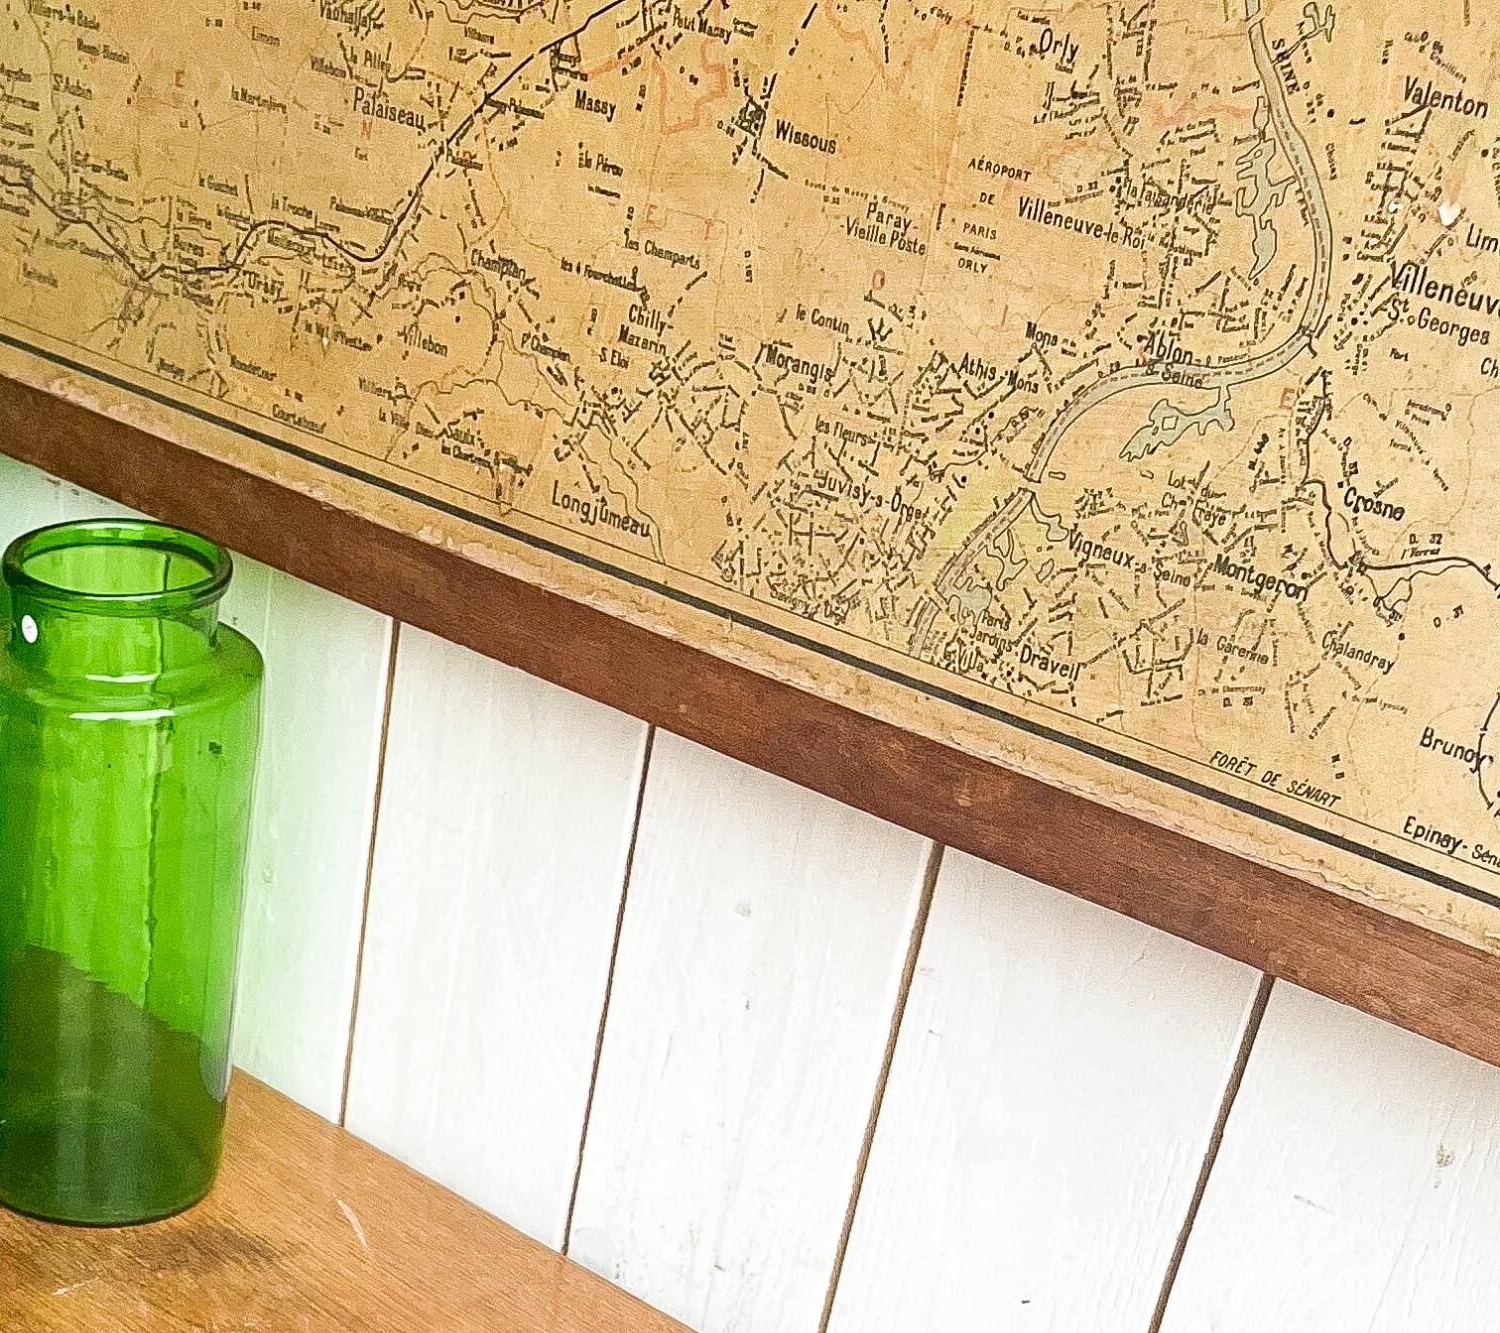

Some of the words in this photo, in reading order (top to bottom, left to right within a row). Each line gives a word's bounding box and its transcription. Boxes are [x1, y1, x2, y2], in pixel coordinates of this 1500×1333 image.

[1039, 27, 1079, 64] Orly
[354, 85, 426, 132] Palaiseau
[575, 88, 617, 123] Massy
[1403, 75, 1490, 120] Valenton
[775, 117, 838, 156] Wissous
[968, 155, 1033, 182] AÉROPORT
[978, 191, 996, 206] DE
[963, 221, 998, 241] PARIS
[957, 257, 989, 275] ORLY
[1391, 260, 1500, 318] Villeneuv
[1024, 320, 1058, 352] Mons
[1417, 305, 1490, 348] Georges
[551, 478, 652, 538] Longjumeau
[1212, 554, 1308, 603] Montgeron
[1018, 642, 1081, 684] Draveil
[1321, 630, 1395, 675] Chalandray
[1419, 726, 1485, 775] Brunoy
[1209, 750, 1258, 779] FORÊT
[1260, 770, 1283, 788] DE
[1286, 778, 1342, 809] SÉNART
